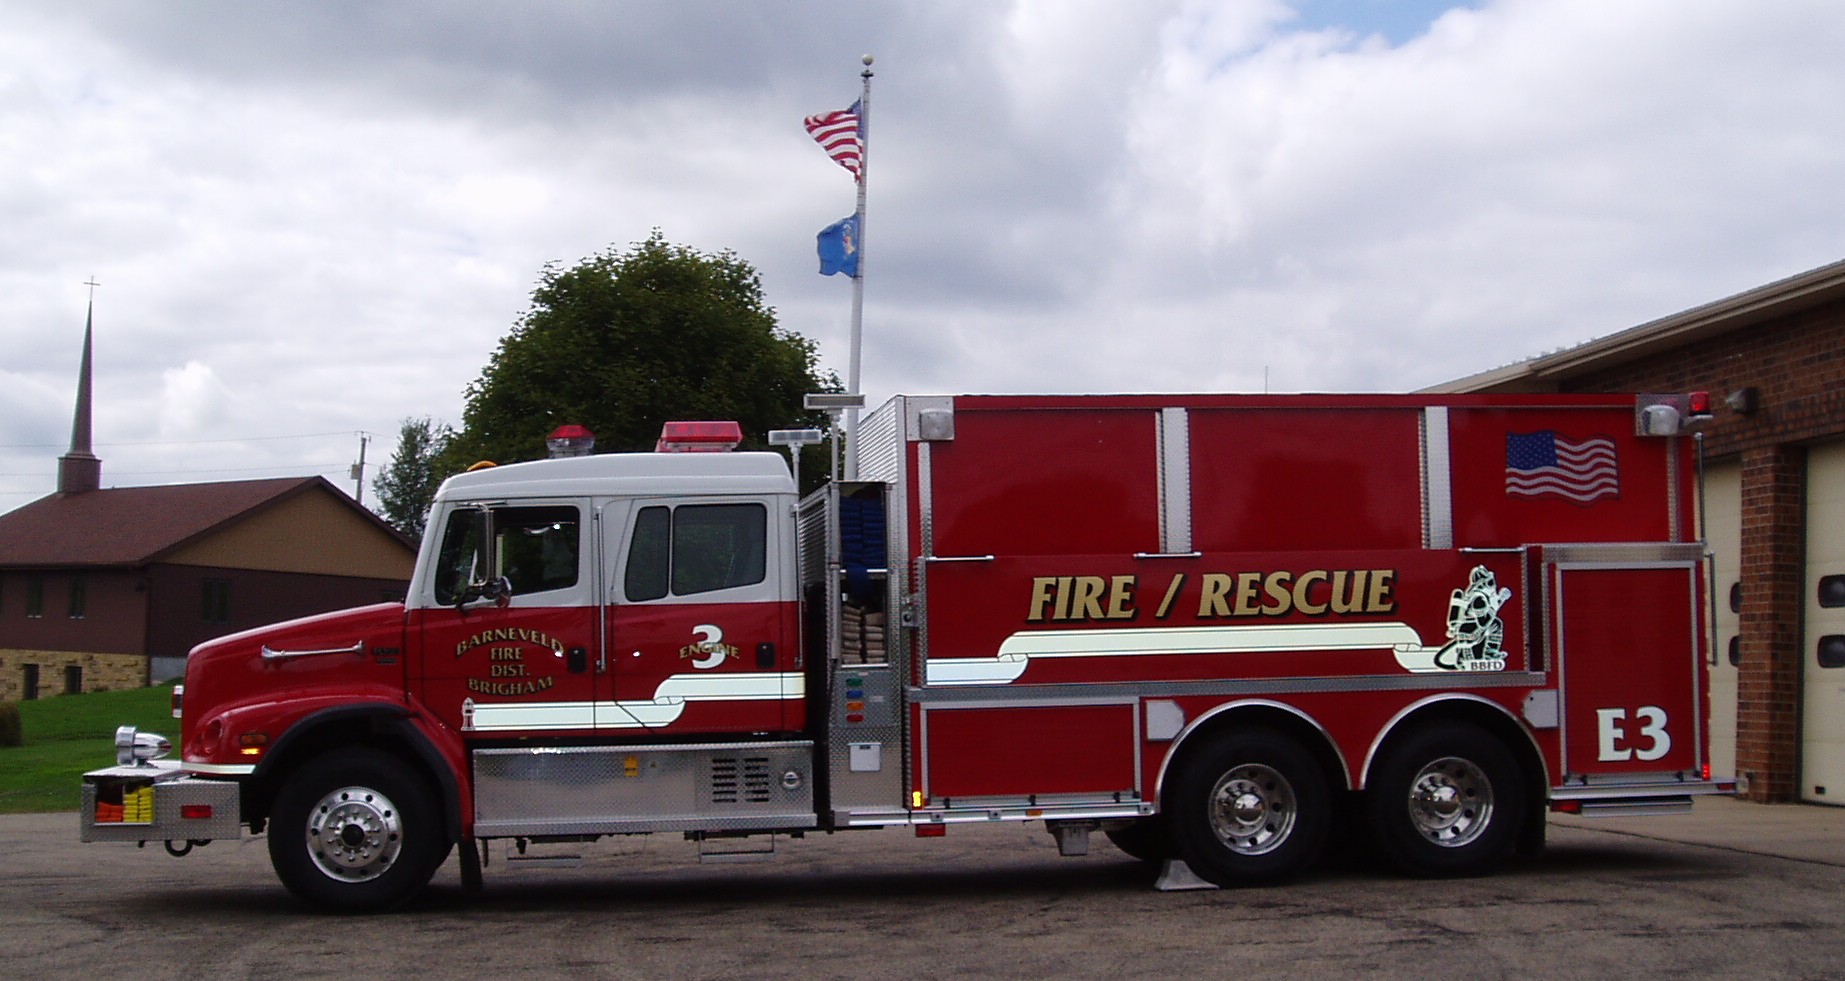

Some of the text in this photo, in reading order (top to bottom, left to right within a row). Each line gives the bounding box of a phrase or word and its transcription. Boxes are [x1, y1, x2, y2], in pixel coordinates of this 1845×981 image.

[1027, 570, 1394, 620] FIRE / RESCUE
[456, 628, 565, 656] BARNEVELD
[679, 643, 740, 660] ENGINE
[691, 624, 726, 669] 3
[491, 647, 523, 660] FIRE
[491, 664, 531, 677] DIST.
[1471, 661, 1503, 670] BBFD
[468, 677, 553, 696] BRIGHAM
[1596, 706, 1671, 761] E3
